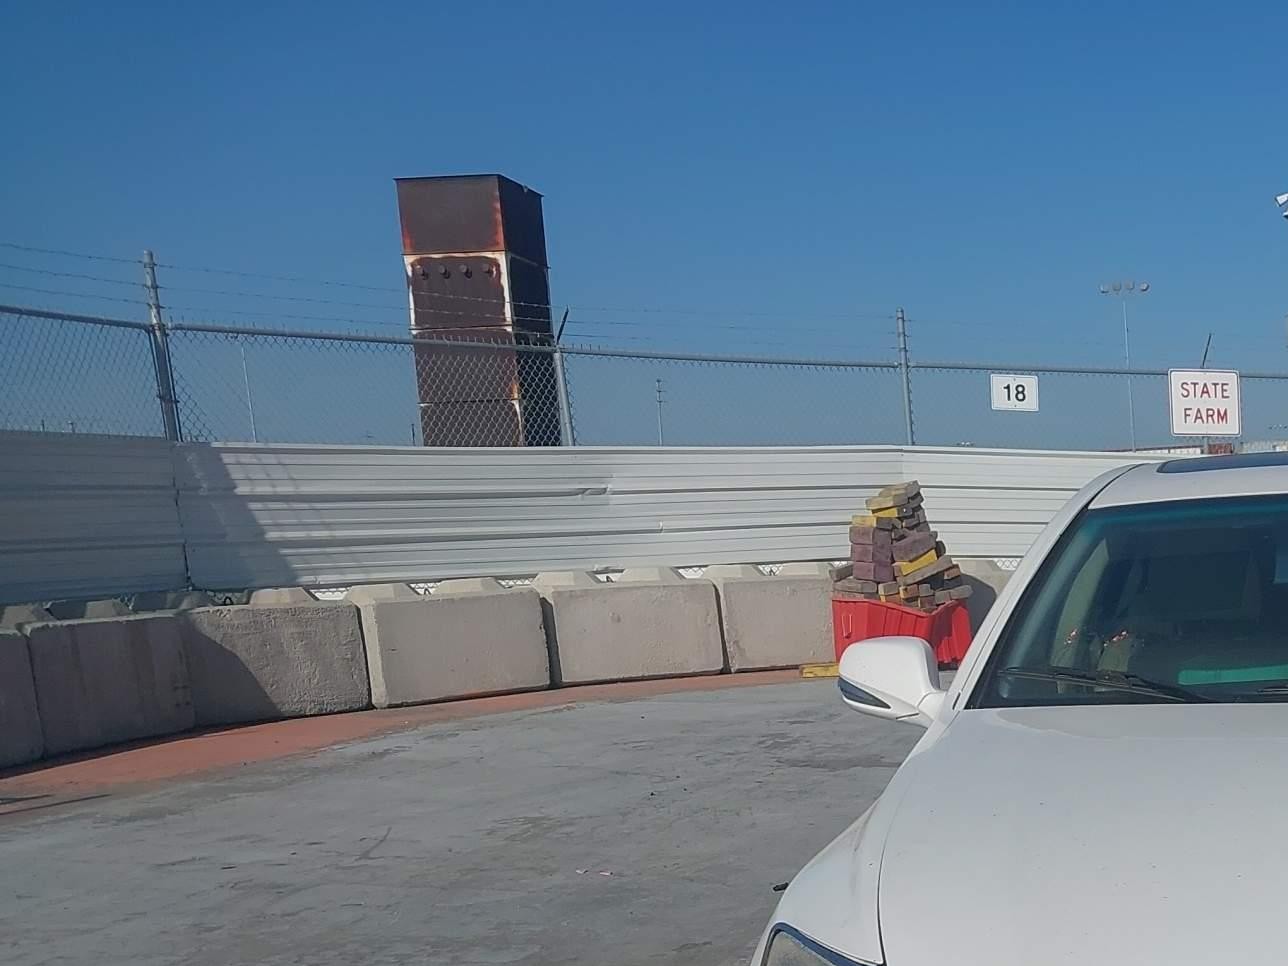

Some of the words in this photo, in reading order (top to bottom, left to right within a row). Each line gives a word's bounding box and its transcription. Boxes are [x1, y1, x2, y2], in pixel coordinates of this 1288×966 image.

[1003, 383, 1027, 403] 18
[1180, 382, 1231, 400] STATE
[1183, 407, 1228, 425] FARM
